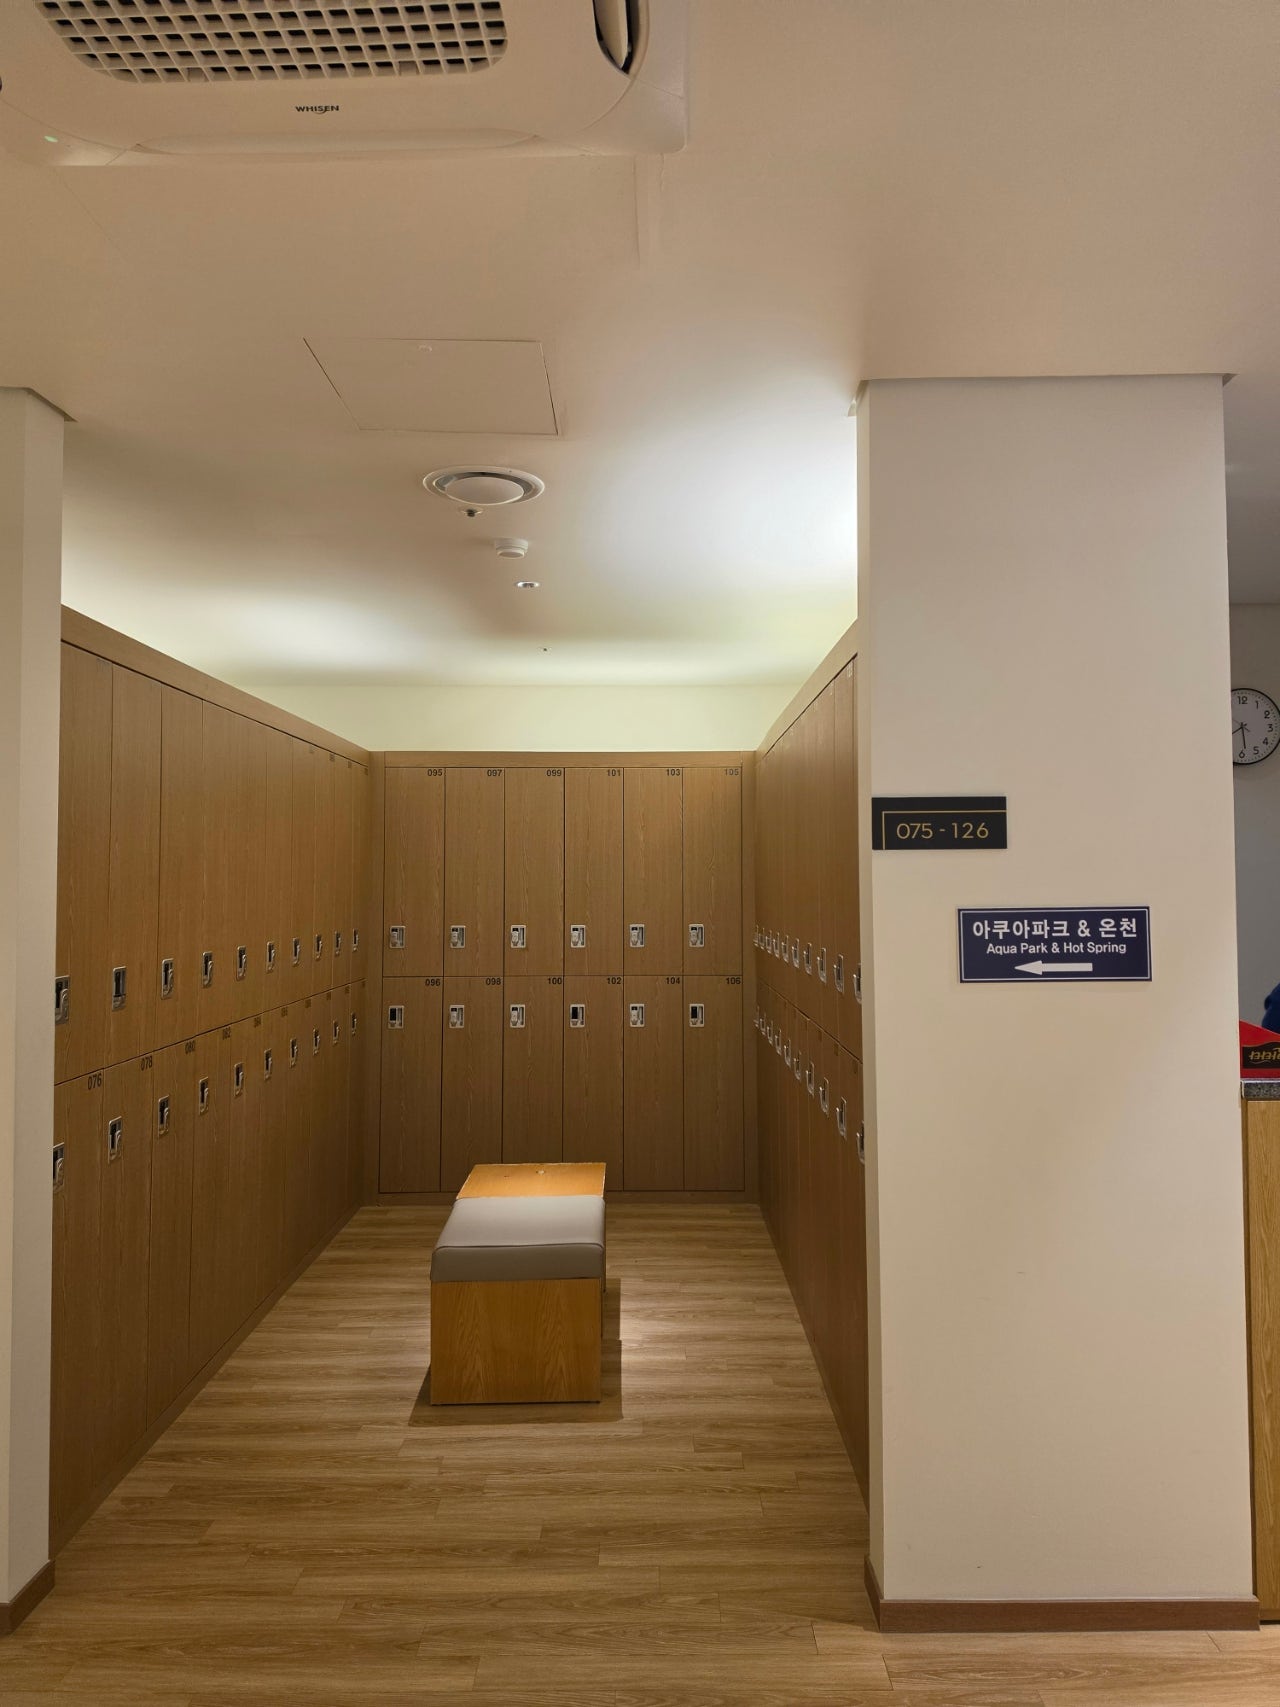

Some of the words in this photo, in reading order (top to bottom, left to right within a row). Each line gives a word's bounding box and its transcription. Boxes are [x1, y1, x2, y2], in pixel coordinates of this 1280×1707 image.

[295, 105, 340, 113] WHISEN
[1237, 695, 1248, 705] 12
[1255, 701, 1259, 710] 1
[1264, 710, 1270, 719] 2
[1267, 723, 1274, 732] 3
[1262, 737, 1269, 746] 4
[1238, 750, 1245, 759] 6
[1253, 745, 1259, 755] 5
[427, 768, 443, 777] 095
[486, 768, 502, 777] 097
[546, 768, 562, 777] 099
[606, 768, 622, 777] 101
[665, 768, 681, 777] 103
[724, 767, 740, 776] 105
[896, 822, 933, 840] 075
[952, 822, 989, 839] 126
[972, 919, 1070, 940] 아쿠아파크
[1077, 920, 1092, 937] &
[1098, 917, 1138, 939] 온천
[986, 943, 1018, 956] Aqua
[1020, 942, 1049, 954] Park
[1051, 942, 1061, 953] &
[1063, 941, 1085, 953] Hot
[1086, 941, 1127, 955] Spring
[425, 978, 441, 987] 096
[485, 977, 502, 986] 098
[547, 977, 562, 985] 100
[606, 976, 622, 985] 102
[665, 976, 681, 985] 104
[725, 976, 741, 985] 106
[140, 1055, 153, 1072] 078
[87, 1073, 102, 1091] 076
